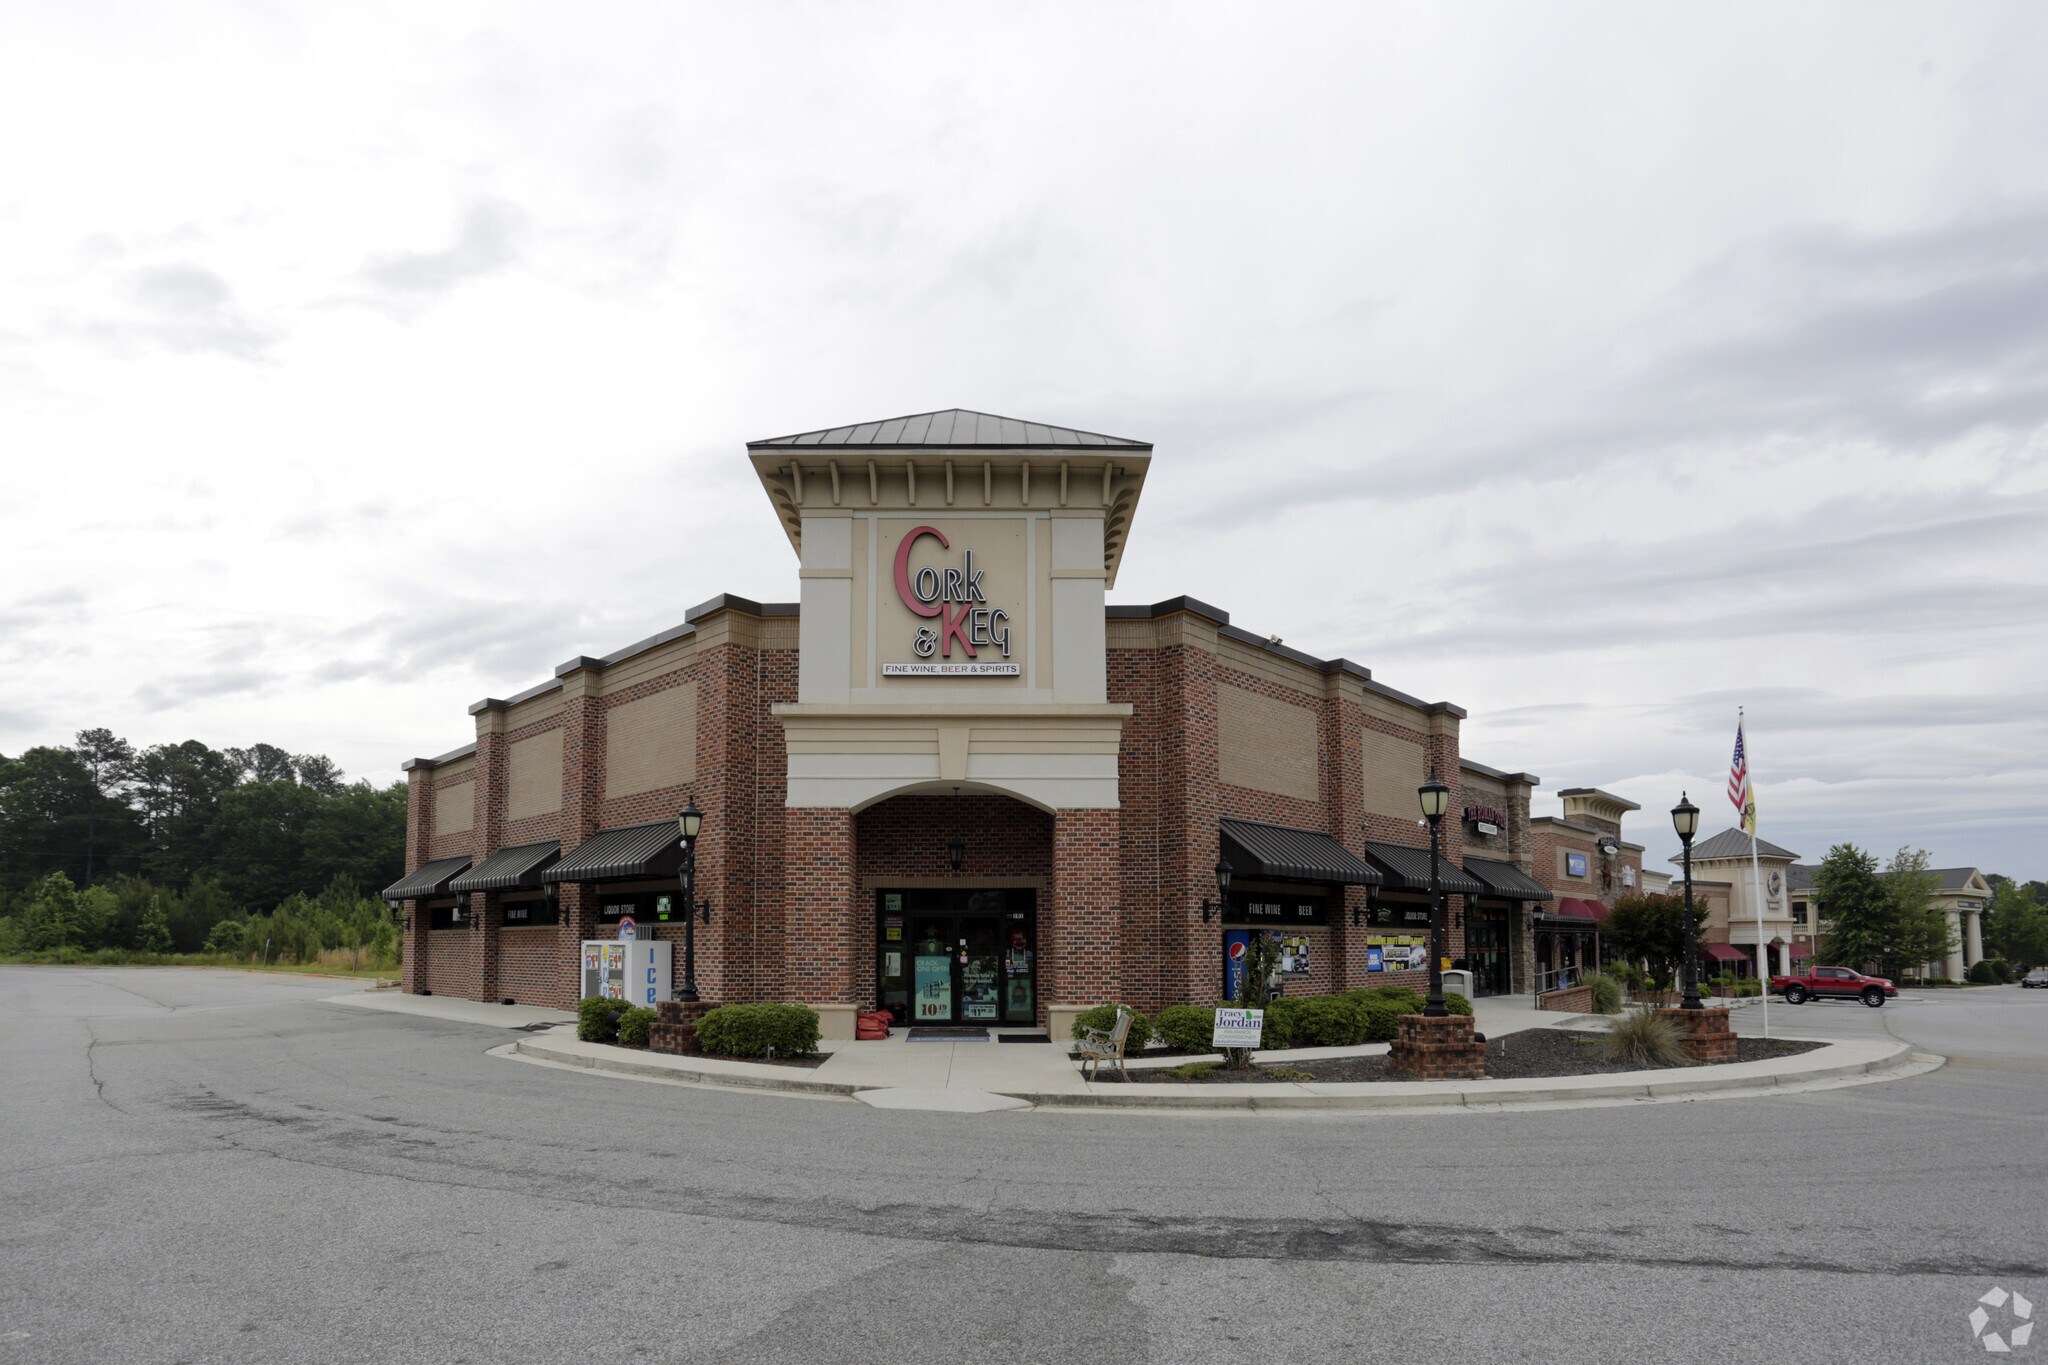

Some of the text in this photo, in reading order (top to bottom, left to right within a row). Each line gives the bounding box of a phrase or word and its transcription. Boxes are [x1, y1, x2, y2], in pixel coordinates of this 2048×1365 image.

[913, 603, 1011, 657] & KEG
[885, 665, 1017, 673] FINE WINE, BEER & SPIRITS
[604, 903, 635, 915] LIQUOR STORE
[1249, 903, 1281, 915] FINE WINE
[1299, 905, 1313, 916] BEER
[921, 1004, 937, 1016] 10
[1219, 1010, 1242, 1019] Tracy
[1216, 1017, 1261, 1028] Jordan
